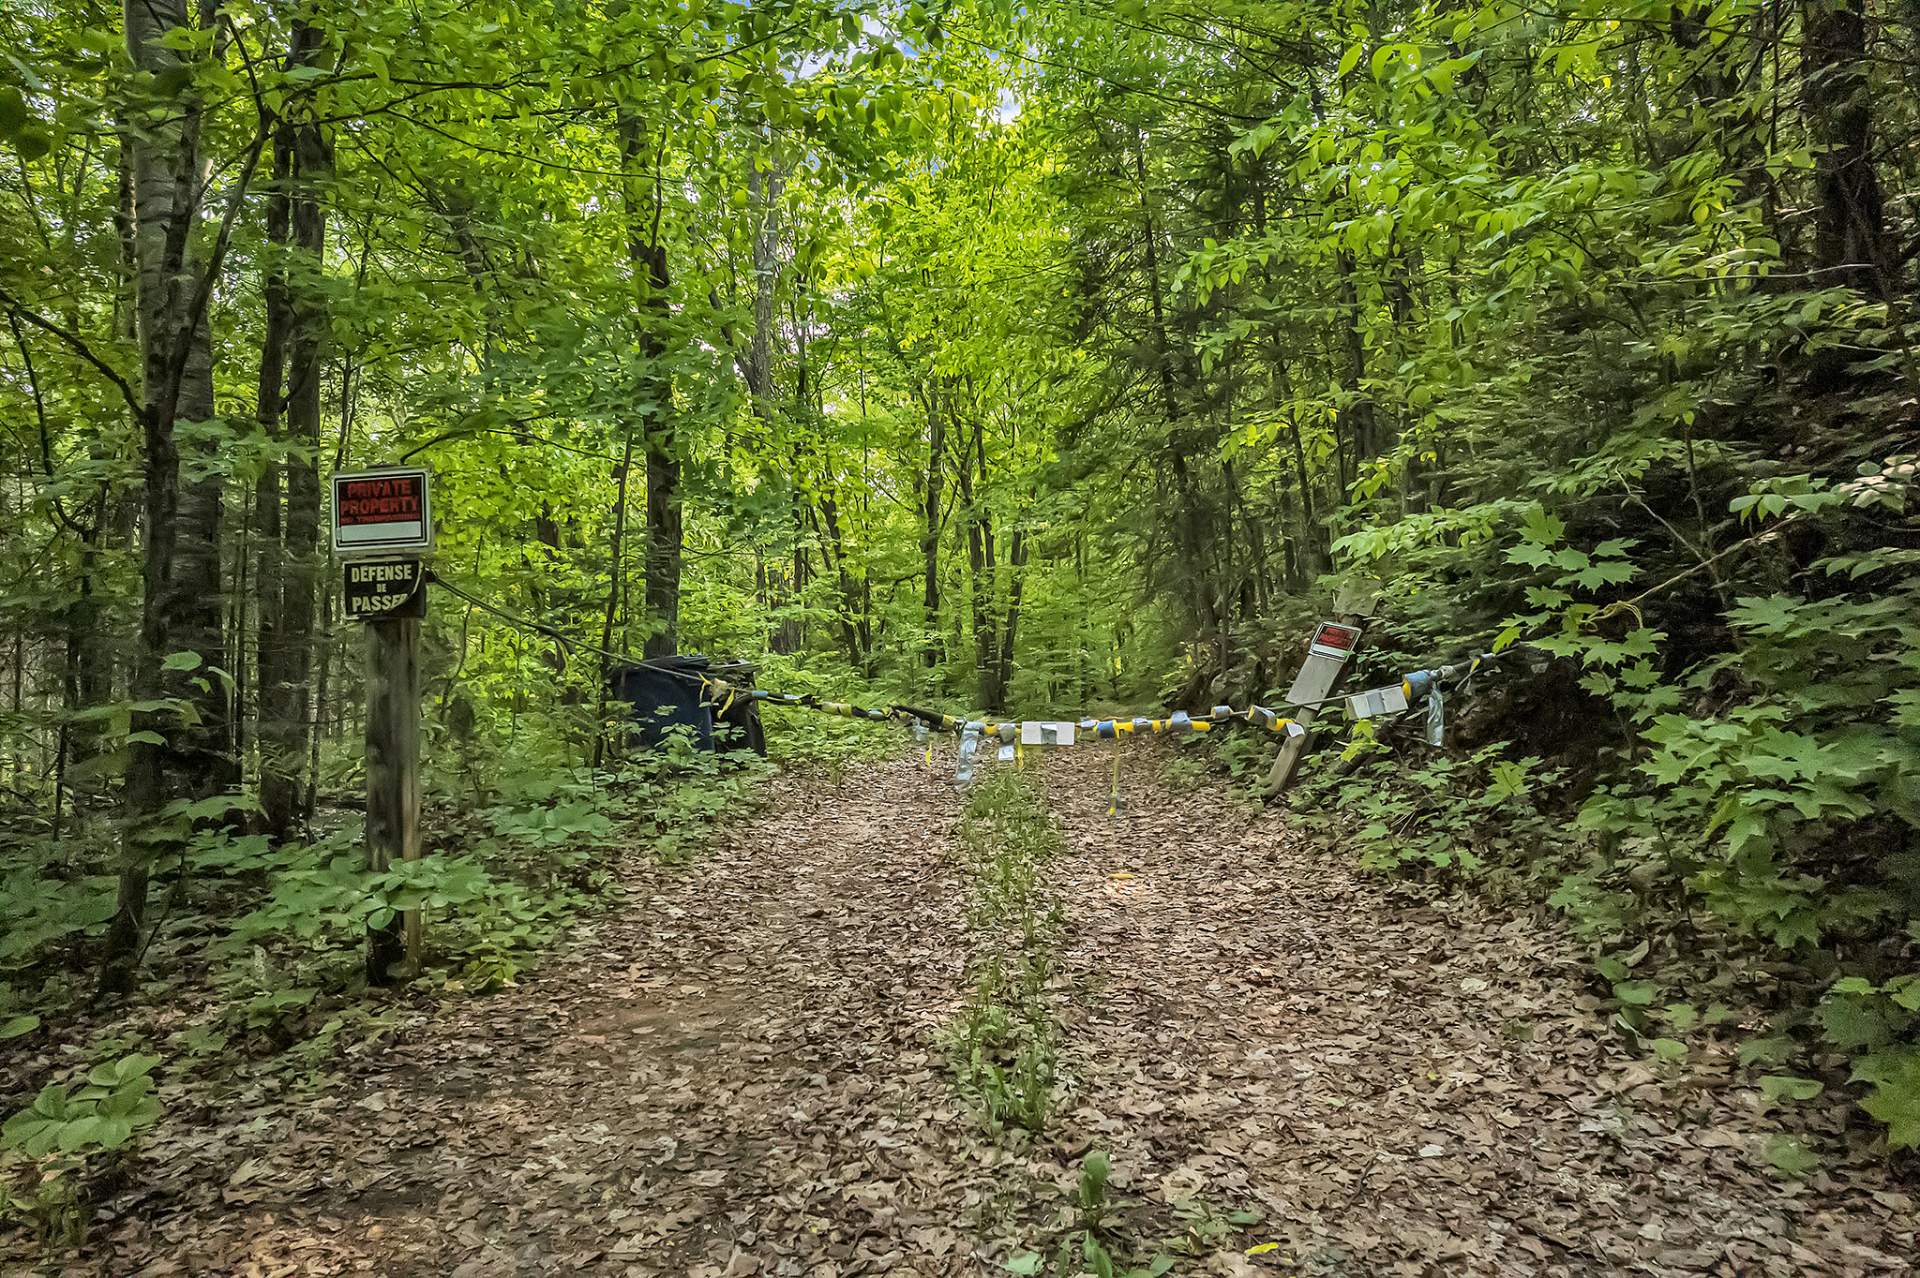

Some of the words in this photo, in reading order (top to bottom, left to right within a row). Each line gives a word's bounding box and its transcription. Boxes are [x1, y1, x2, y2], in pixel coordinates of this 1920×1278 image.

[348, 479, 411, 498] PRIVATE
[341, 495, 417, 515] PROPERTY
[376, 583, 387, 593] DE
